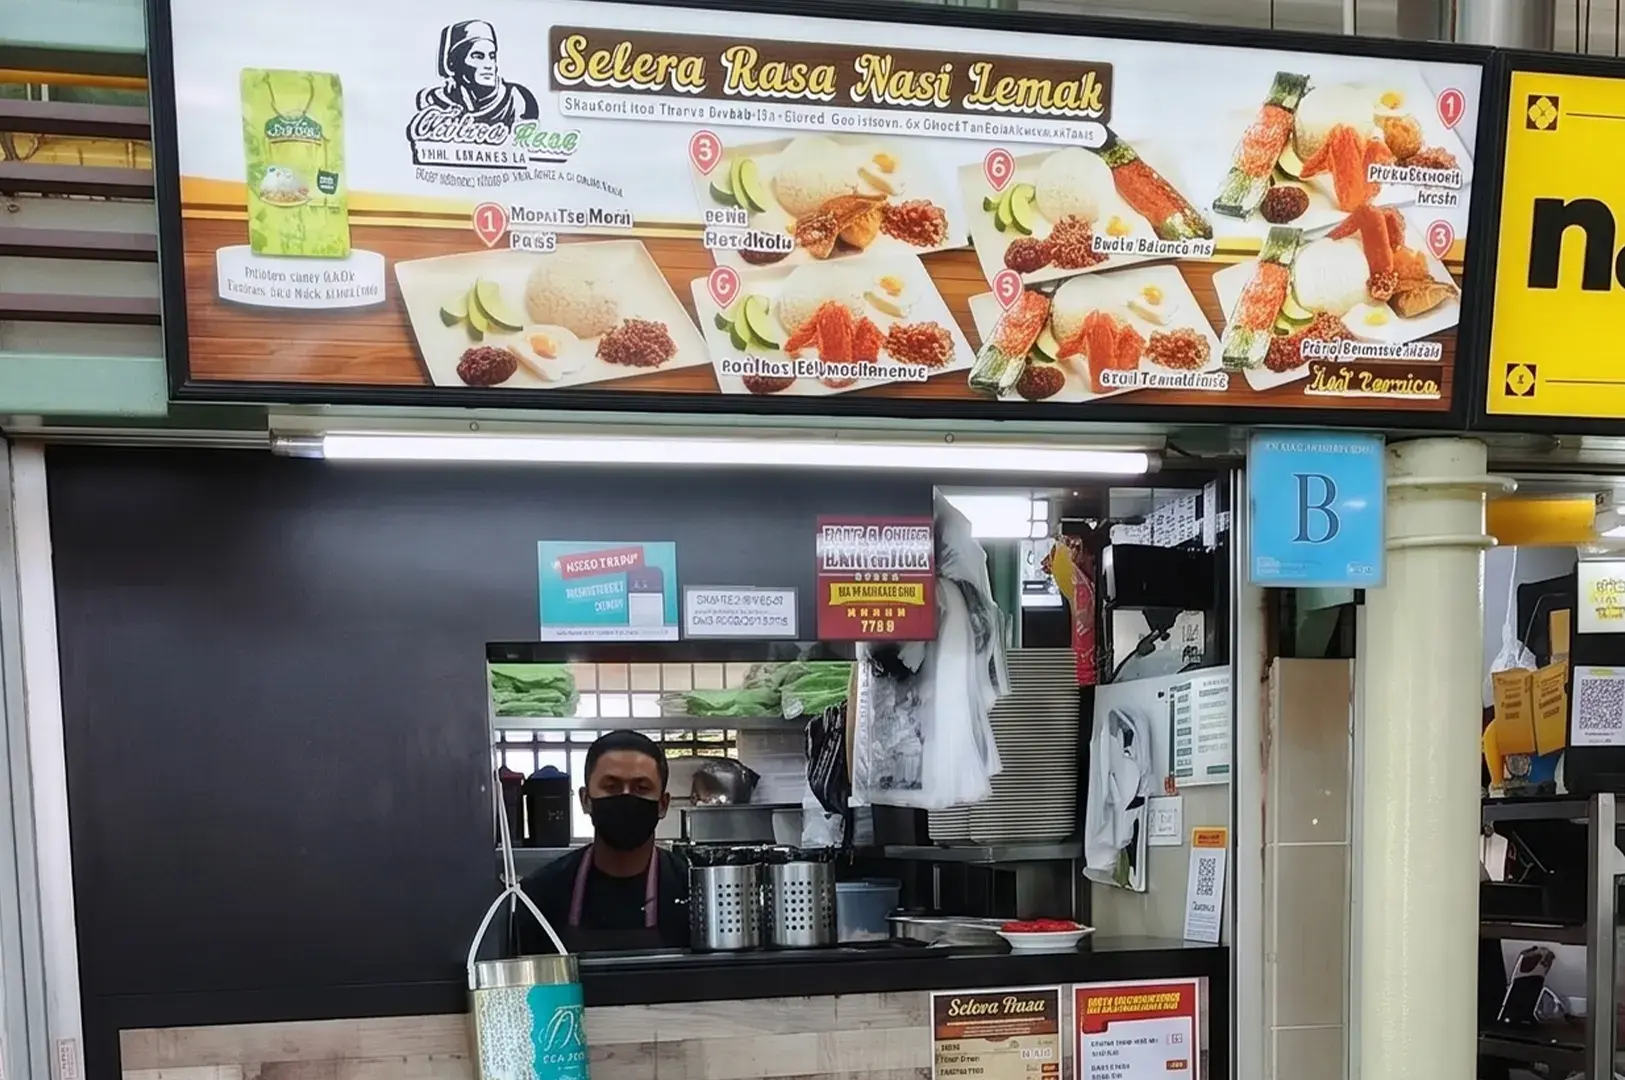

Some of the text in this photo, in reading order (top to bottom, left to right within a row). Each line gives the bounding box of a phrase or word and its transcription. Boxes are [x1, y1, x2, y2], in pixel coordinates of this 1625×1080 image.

[554, 34, 1104, 118] Selera Rasa Nasi Lemak
[1446, 95, 1455, 117] 1
[699, 138, 712, 161] 3
[991, 155, 1006, 178] 6
[482, 210, 497, 233] 1
[1433, 227, 1447, 249] 3
[1527, 197, 1625, 292] n
[1292, 473, 1340, 544] B
